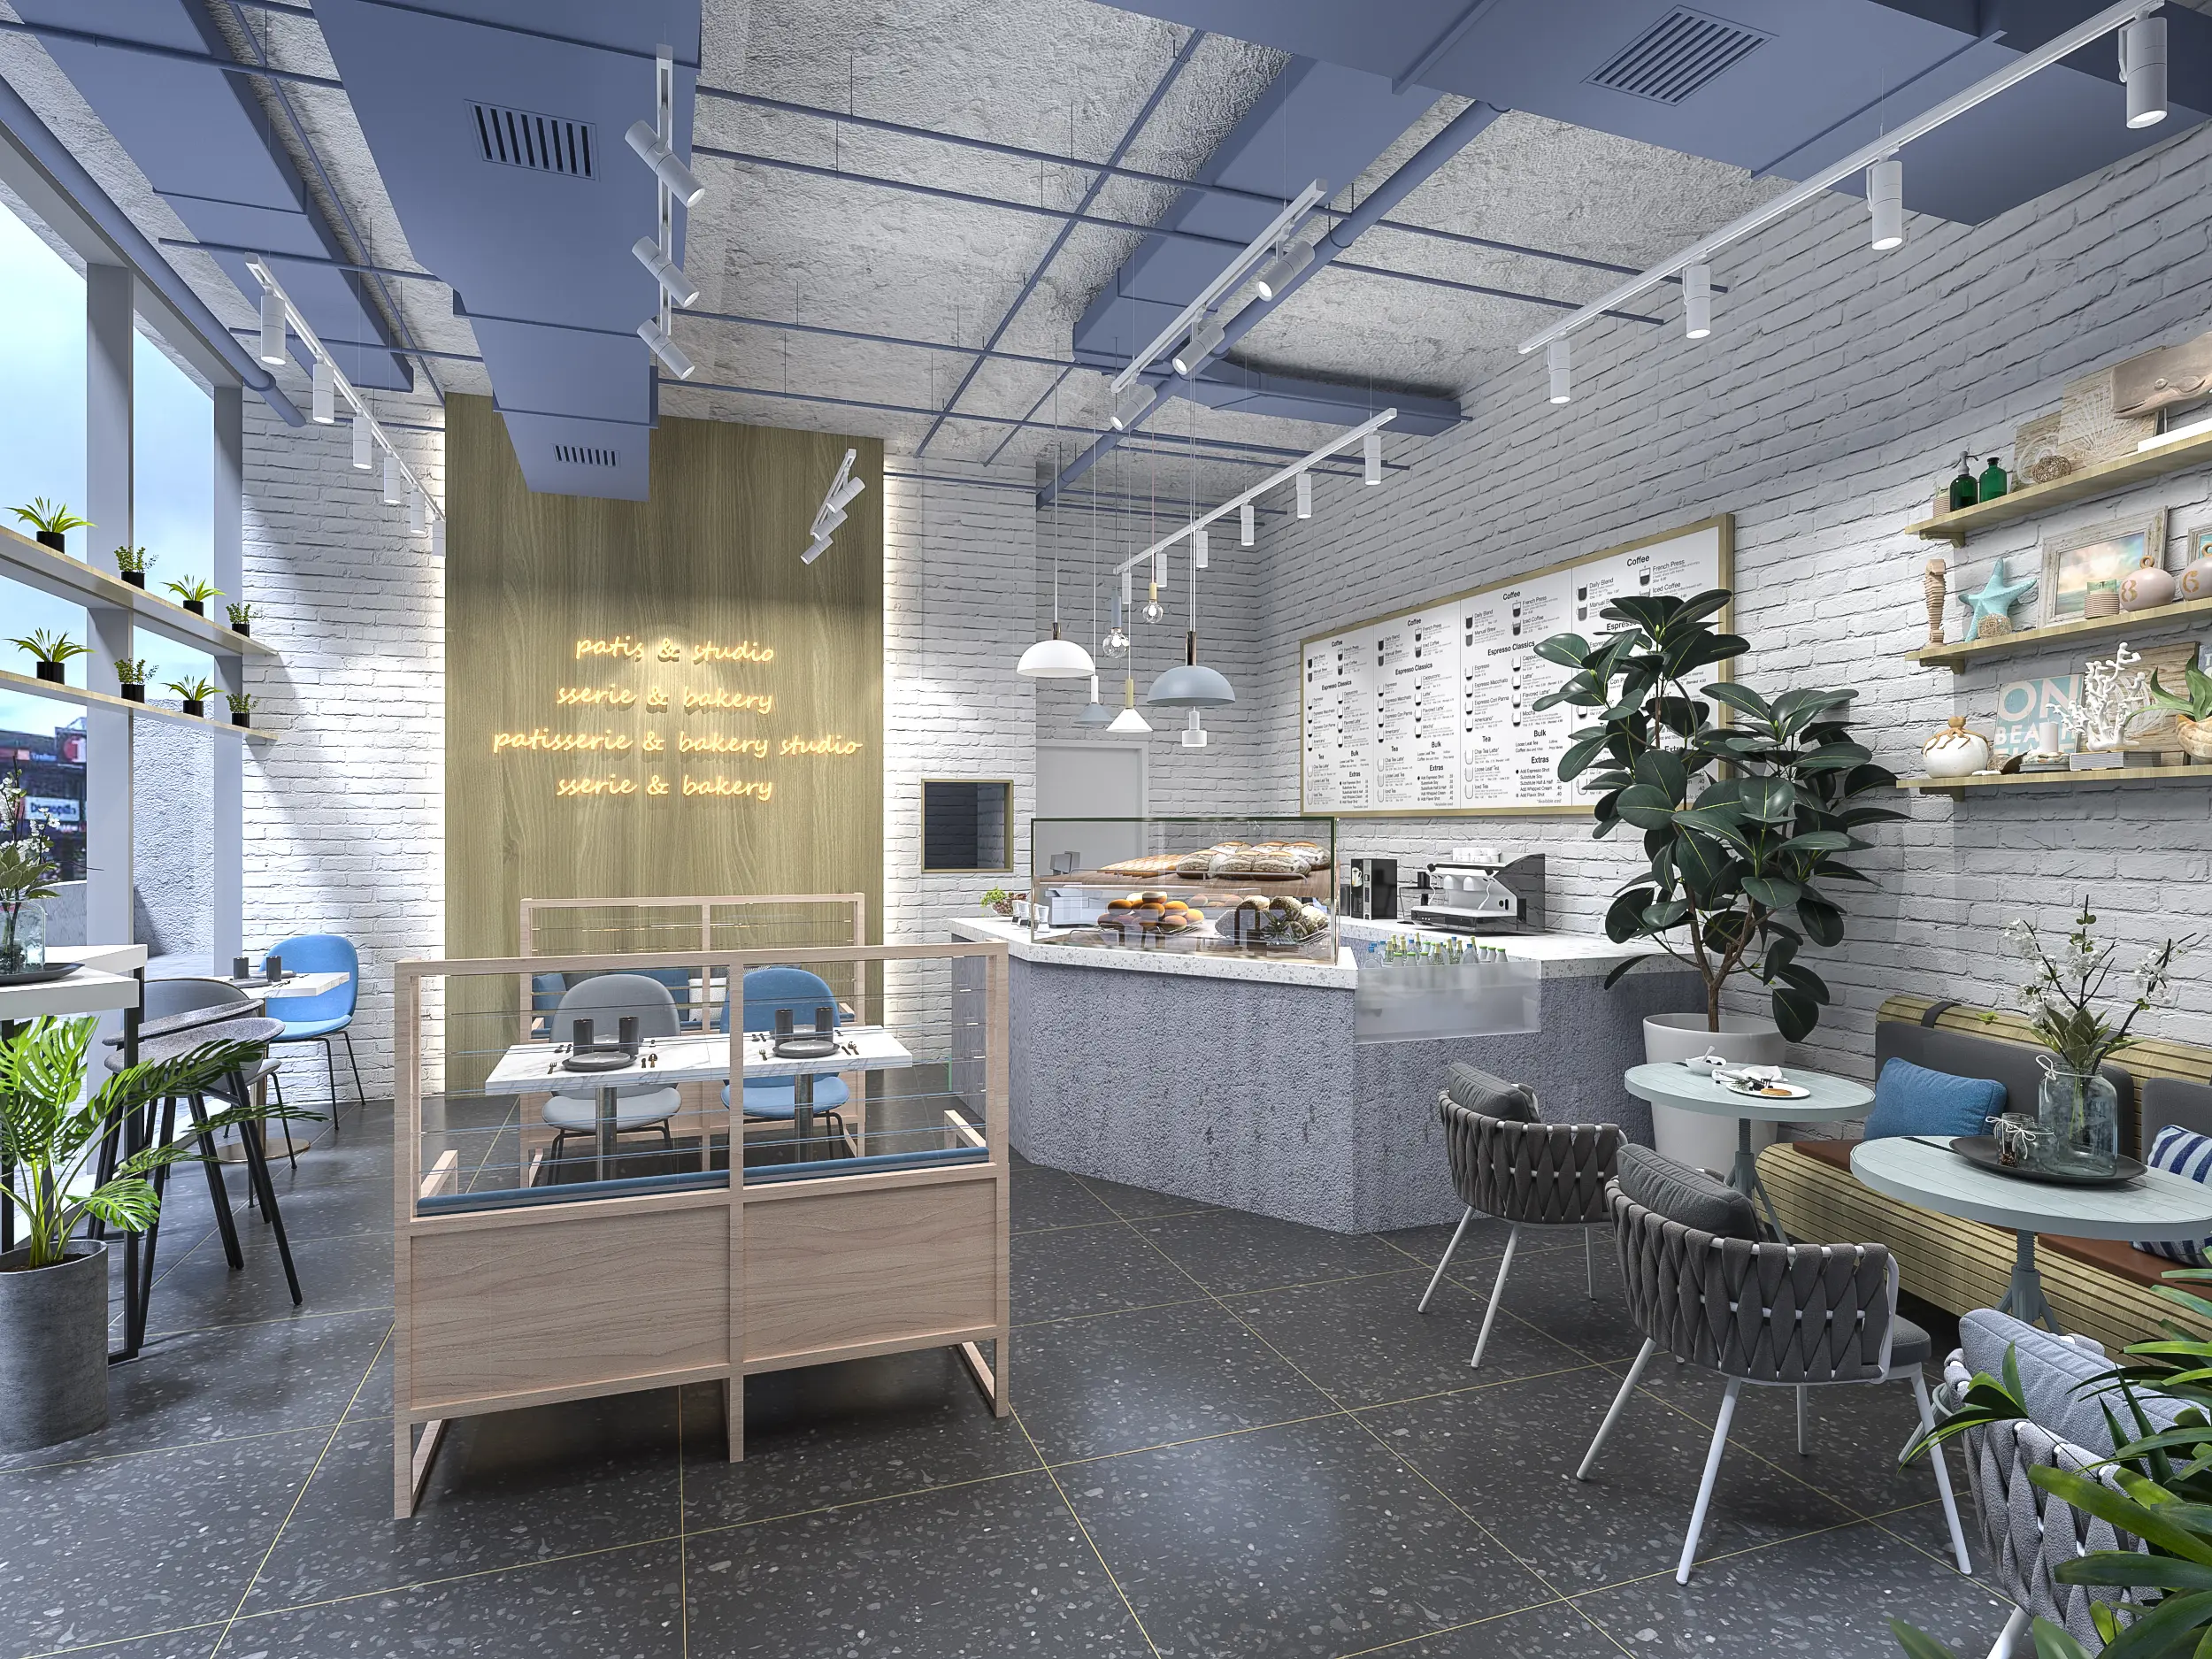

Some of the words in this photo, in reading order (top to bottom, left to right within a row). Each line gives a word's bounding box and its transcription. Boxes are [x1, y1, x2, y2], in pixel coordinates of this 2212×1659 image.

[1627, 555, 1649, 566] Coffee
[1653, 563, 1669, 572] French
[2121, 580, 2138, 602] 8
[2183, 571, 2200, 593] 6
[1503, 591, 1520, 600] Coffee
[575, 636, 643, 659] patis
[657, 638, 680, 659] &
[692, 638, 774, 662] studio
[1487, 646, 1511, 656] Espresso
[1512, 641, 1535, 650] Classics
[1395, 667, 1414, 676] Espresso
[557, 684, 638, 706] sserie
[646, 687, 669, 707] &
[683, 686, 772, 714] bakery
[1999, 674, 2079, 721] ON
[493, 727, 634, 753] patisserie
[641, 732, 664, 751] &
[679, 731, 768, 758] bakery
[780, 734, 863, 756] studio
[1994, 723, 2076, 745] BEAH
[557, 774, 638, 796] sserie
[646, 775, 669, 795] &
[683, 775, 772, 801] bakery
